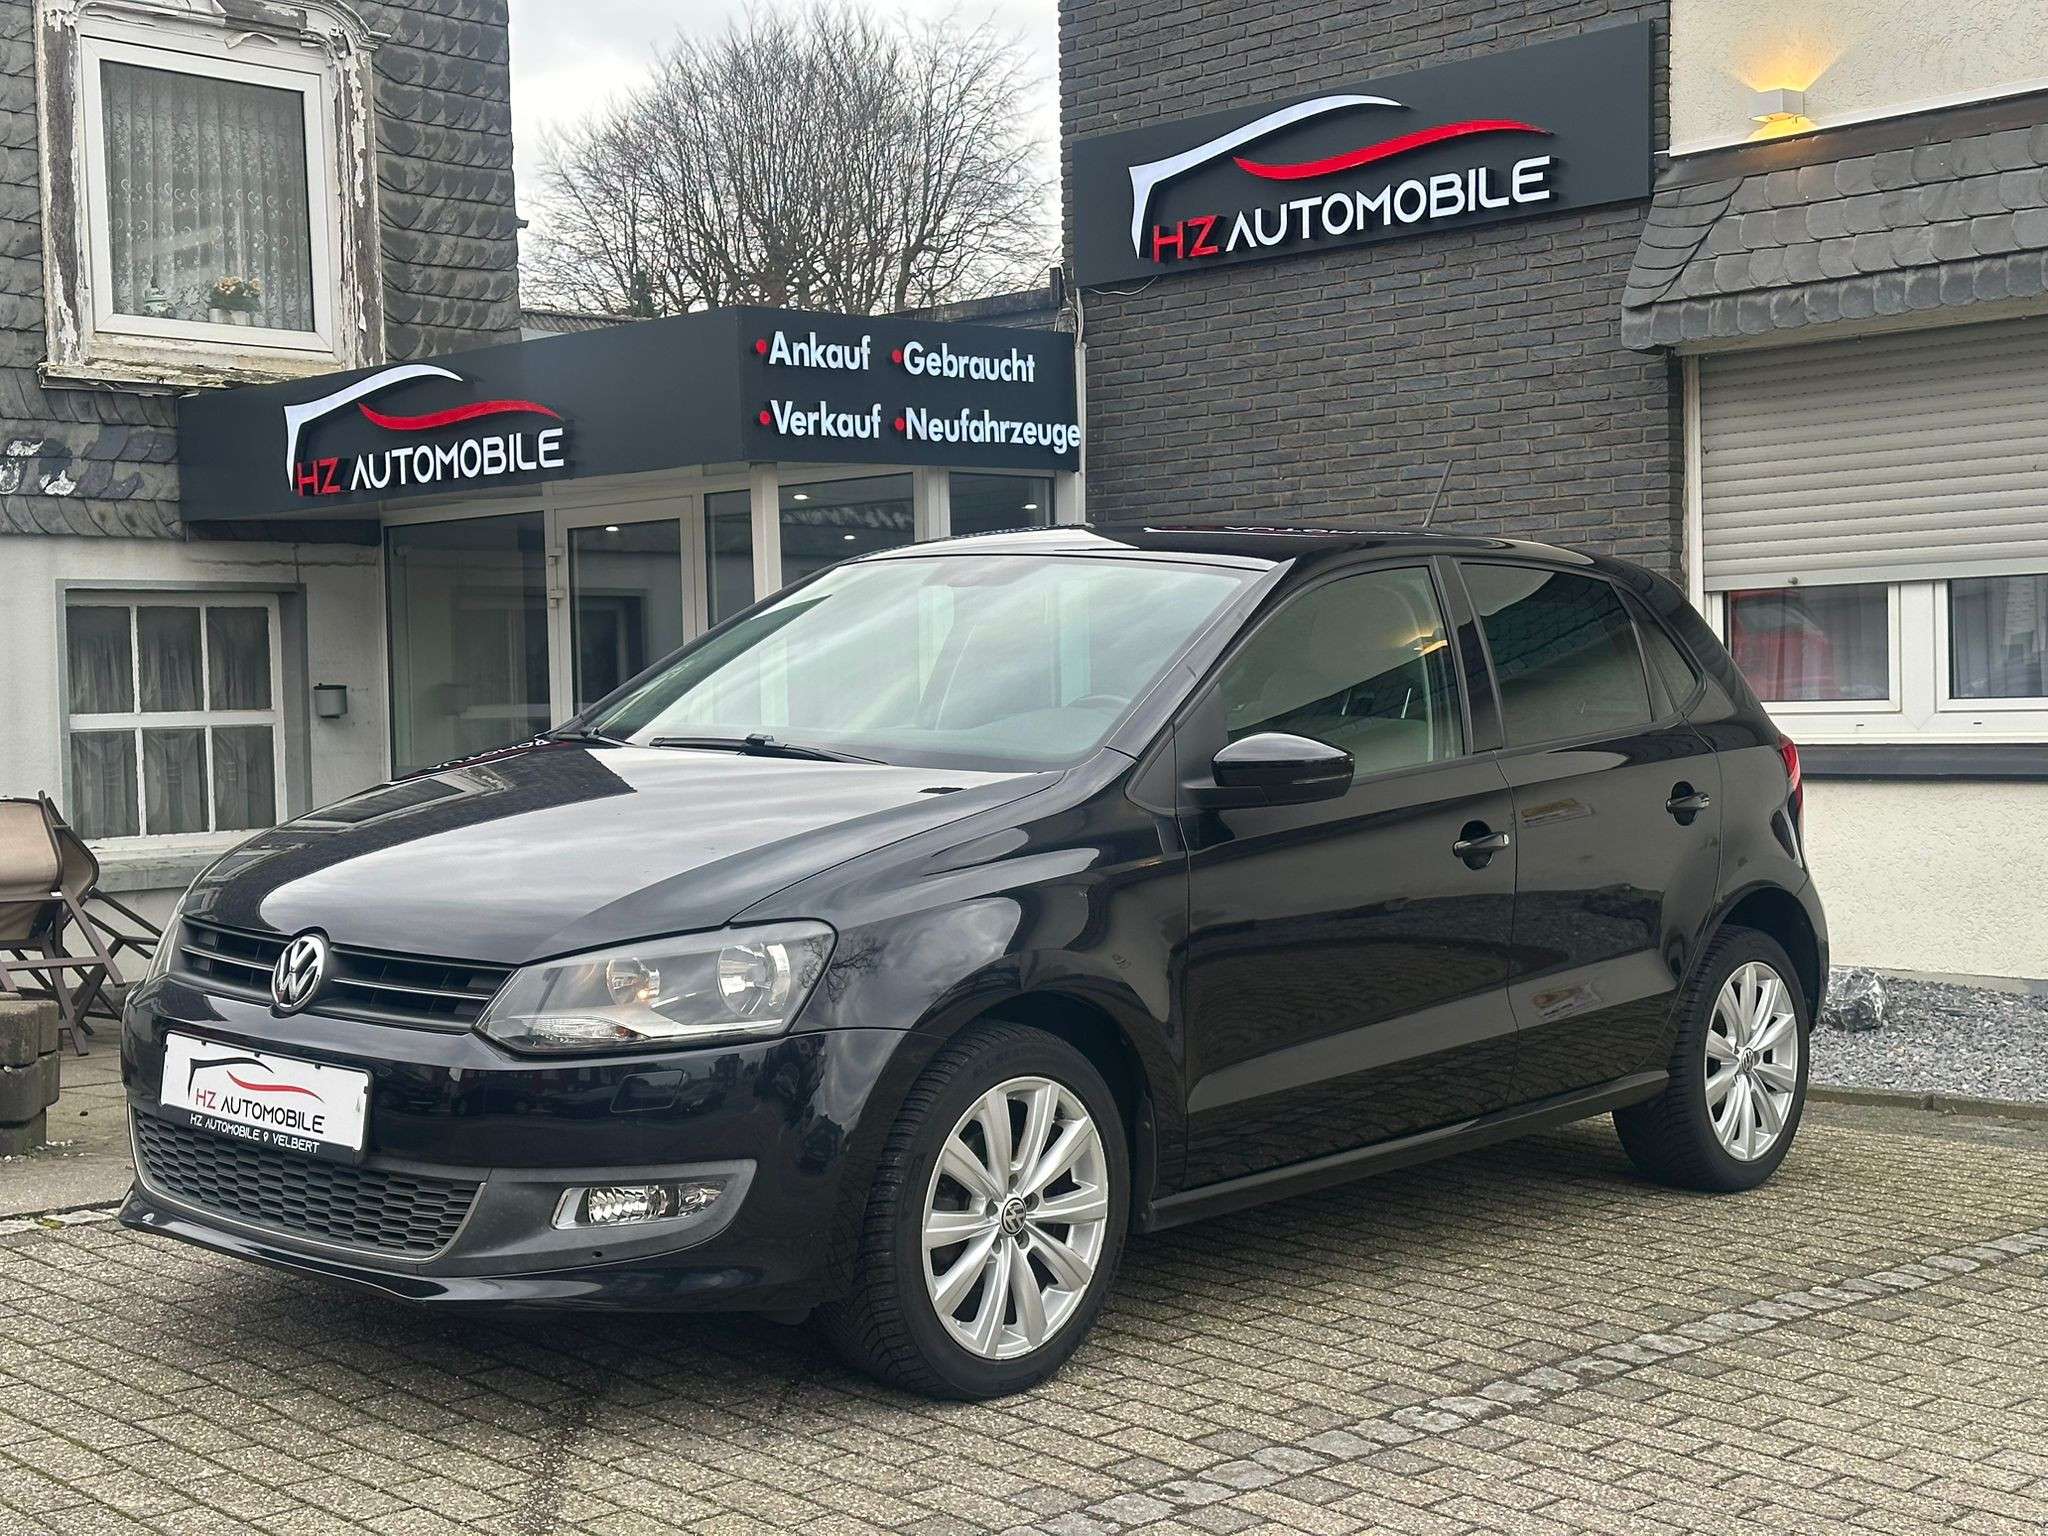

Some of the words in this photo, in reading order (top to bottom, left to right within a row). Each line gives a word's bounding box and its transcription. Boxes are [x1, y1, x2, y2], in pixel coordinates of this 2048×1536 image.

[1152, 215, 1220, 264] HZ
[1225, 155, 1551, 253] AUTOMOBILE
[768, 331, 871, 371] Ankauf
[903, 341, 1035, 383] Gebraucht
[770, 400, 882, 439] Verkauf
[905, 407, 1081, 455] Neufahrzeuge
[296, 456, 342, 497] HZ
[350, 427, 564, 491] AUTOMOBILE
[196, 1088, 216, 1109] HZ
[220, 1096, 325, 1134] AUTOMOBILE
[190, 1114, 203, 1127] HZ
[205, 1119, 260, 1141] AUTOMOBILE
[272, 1134, 320, 1154] VELBERT
